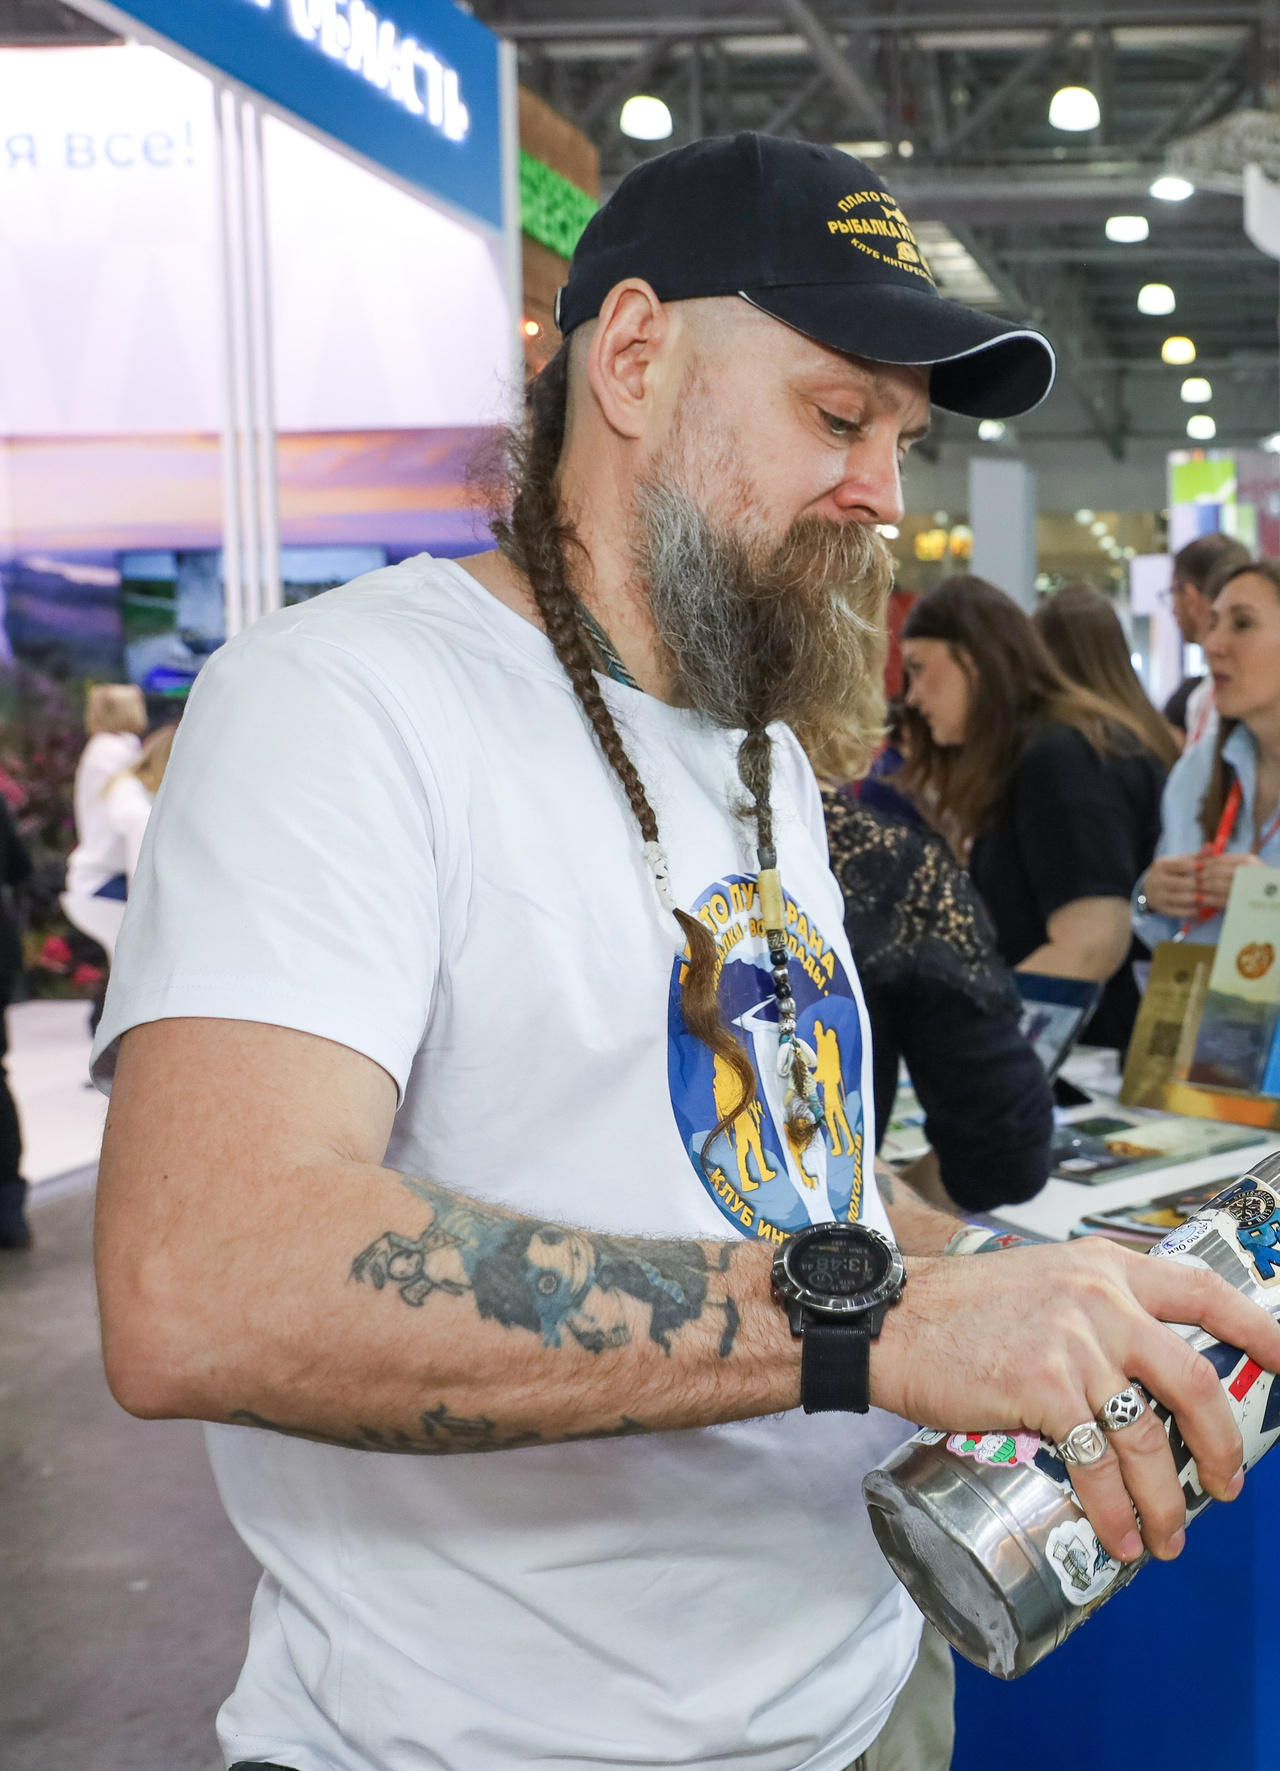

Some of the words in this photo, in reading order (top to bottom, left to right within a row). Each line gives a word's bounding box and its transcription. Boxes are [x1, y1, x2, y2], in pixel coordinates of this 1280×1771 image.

[65, 119, 194, 169] все!
[837, 191, 881, 213] ПЛАТО
[827, 218, 901, 239] РЫБАЛКА
[850, 237, 881, 260] КЛУБ
[882, 254, 929, 278] ИНТЕРЕС
[728, 882, 835, 980] ПУРАНА
[709, 1167, 755, 1227] КЛУБ
